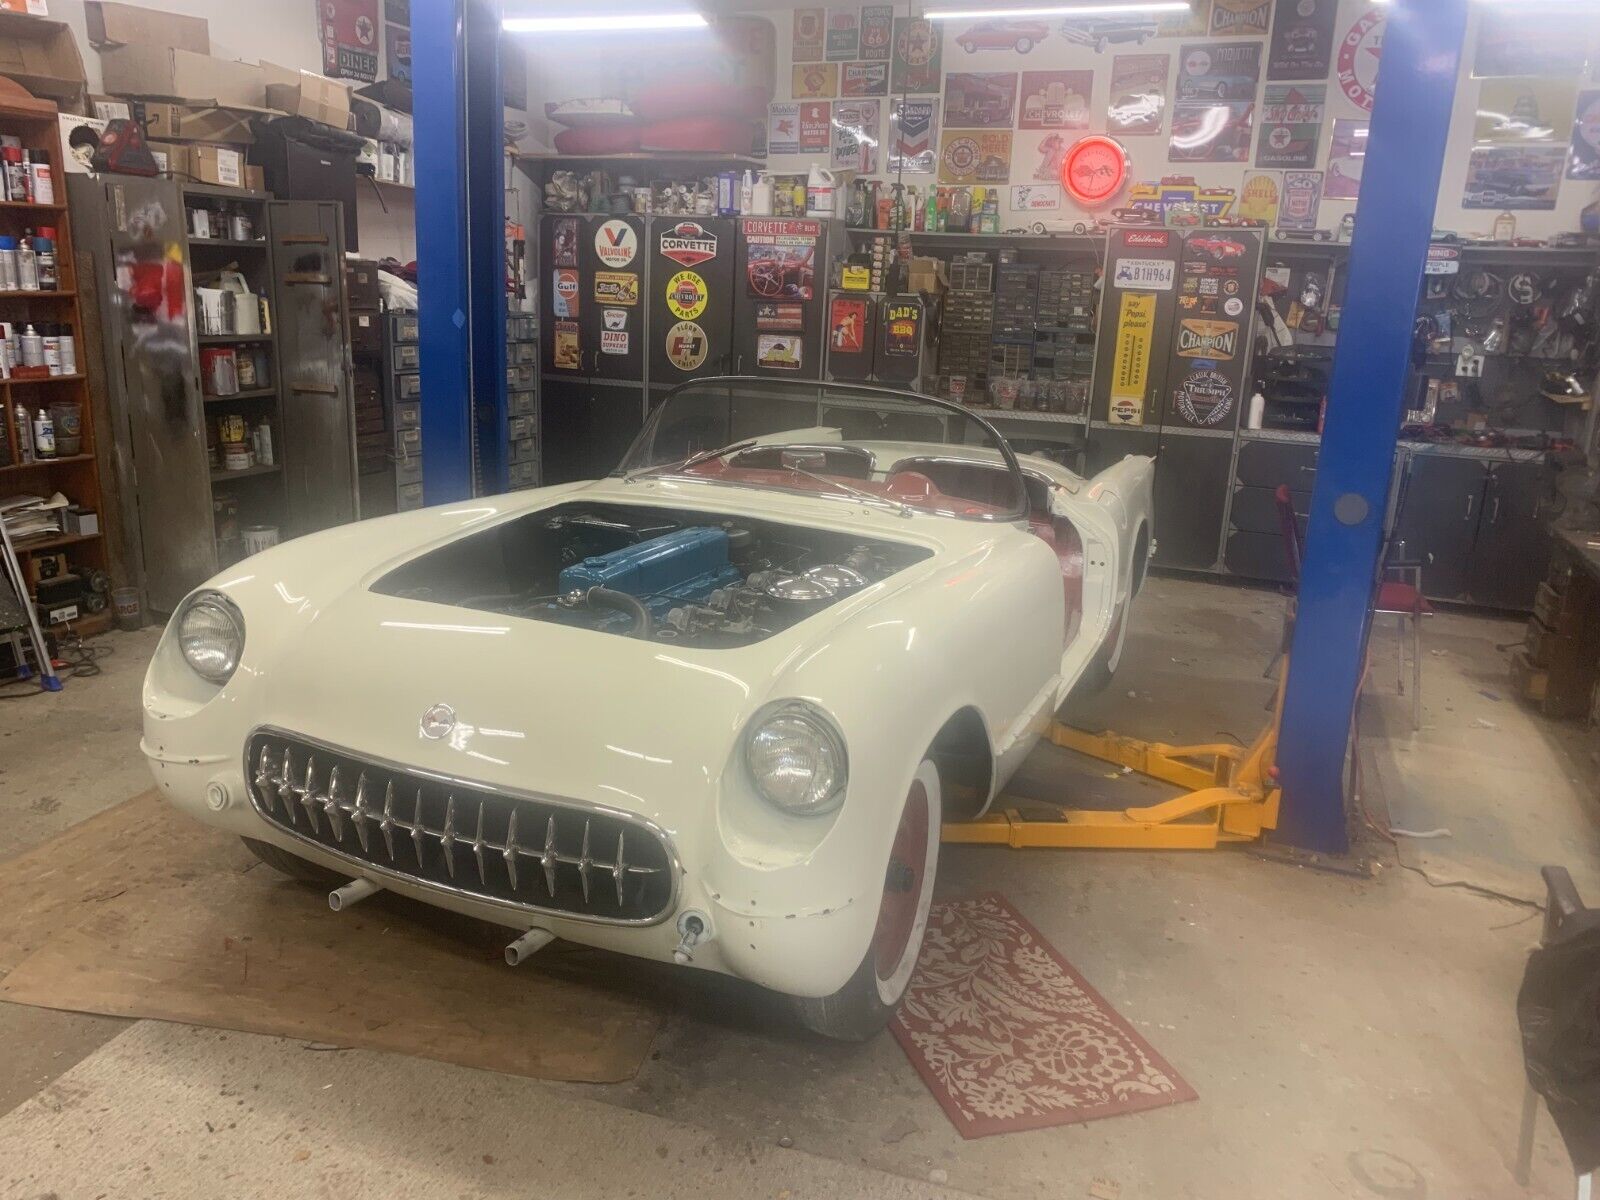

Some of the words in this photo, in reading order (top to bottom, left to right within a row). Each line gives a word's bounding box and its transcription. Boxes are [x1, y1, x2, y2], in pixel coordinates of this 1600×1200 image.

[1213, 7, 1267, 29] CHAMPION
[868, 34, 882, 44] 66
[865, 49, 886, 58] ROUTE
[339, 51, 376, 71] DINER
[848, 69, 883, 77] CHAMPION
[897, 105, 932, 118] SANDARD
[1028, 109, 1082, 119] CHEVROLET
[1132, 202, 1219, 214] CHEVET
[747, 222, 788, 234] CORVETTE
[747, 236, 774, 244] CAUTION
[1127, 233, 1165, 244] Edelbrock
[662, 240, 715, 252] CORVETTE
[600, 246, 631, 258] VALVOLINE
[674, 274, 685, 283] WE
[687, 274, 702, 286] USE
[557, 282, 578, 290] Gulf
[669, 293, 704, 301] CHEVROLET
[1128, 301, 1139, 309] say
[674, 307, 699, 318] PARTS
[889, 307, 918, 320] DAD'S
[677, 323, 697, 333] FLOOR
[892, 324, 913, 335] BBQ
[603, 333, 627, 342] DINO
[1179, 329, 1234, 354] CHAMPION
[1189, 371, 1208, 382] CLASSIC
[1209, 371, 1228, 384] BRITISH
[1188, 384, 1226, 397] TRIUMPH
